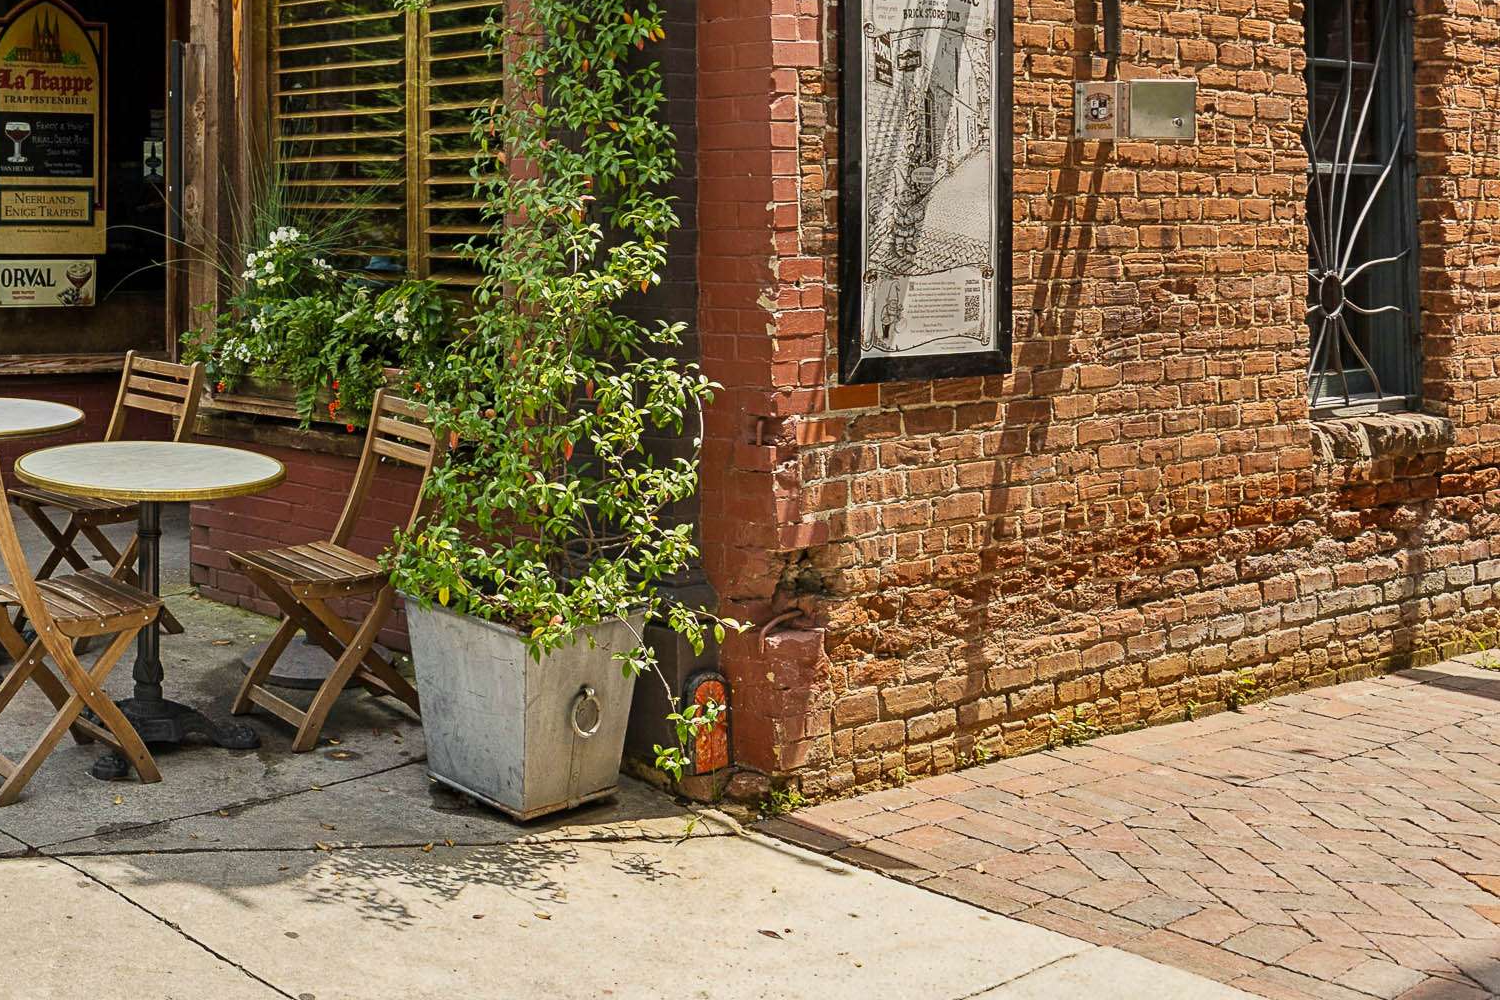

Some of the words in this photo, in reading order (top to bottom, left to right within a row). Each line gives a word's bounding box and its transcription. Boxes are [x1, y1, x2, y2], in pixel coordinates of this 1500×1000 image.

[25, 69, 94, 95] Trappe
[3, 95, 88, 105] TRAPPISTENBIER
[14, 192, 76, 205] NEERLANDS
[36, 205, 85, 218] TRAPPIST
[1, 267, 56, 288] ORVAL
